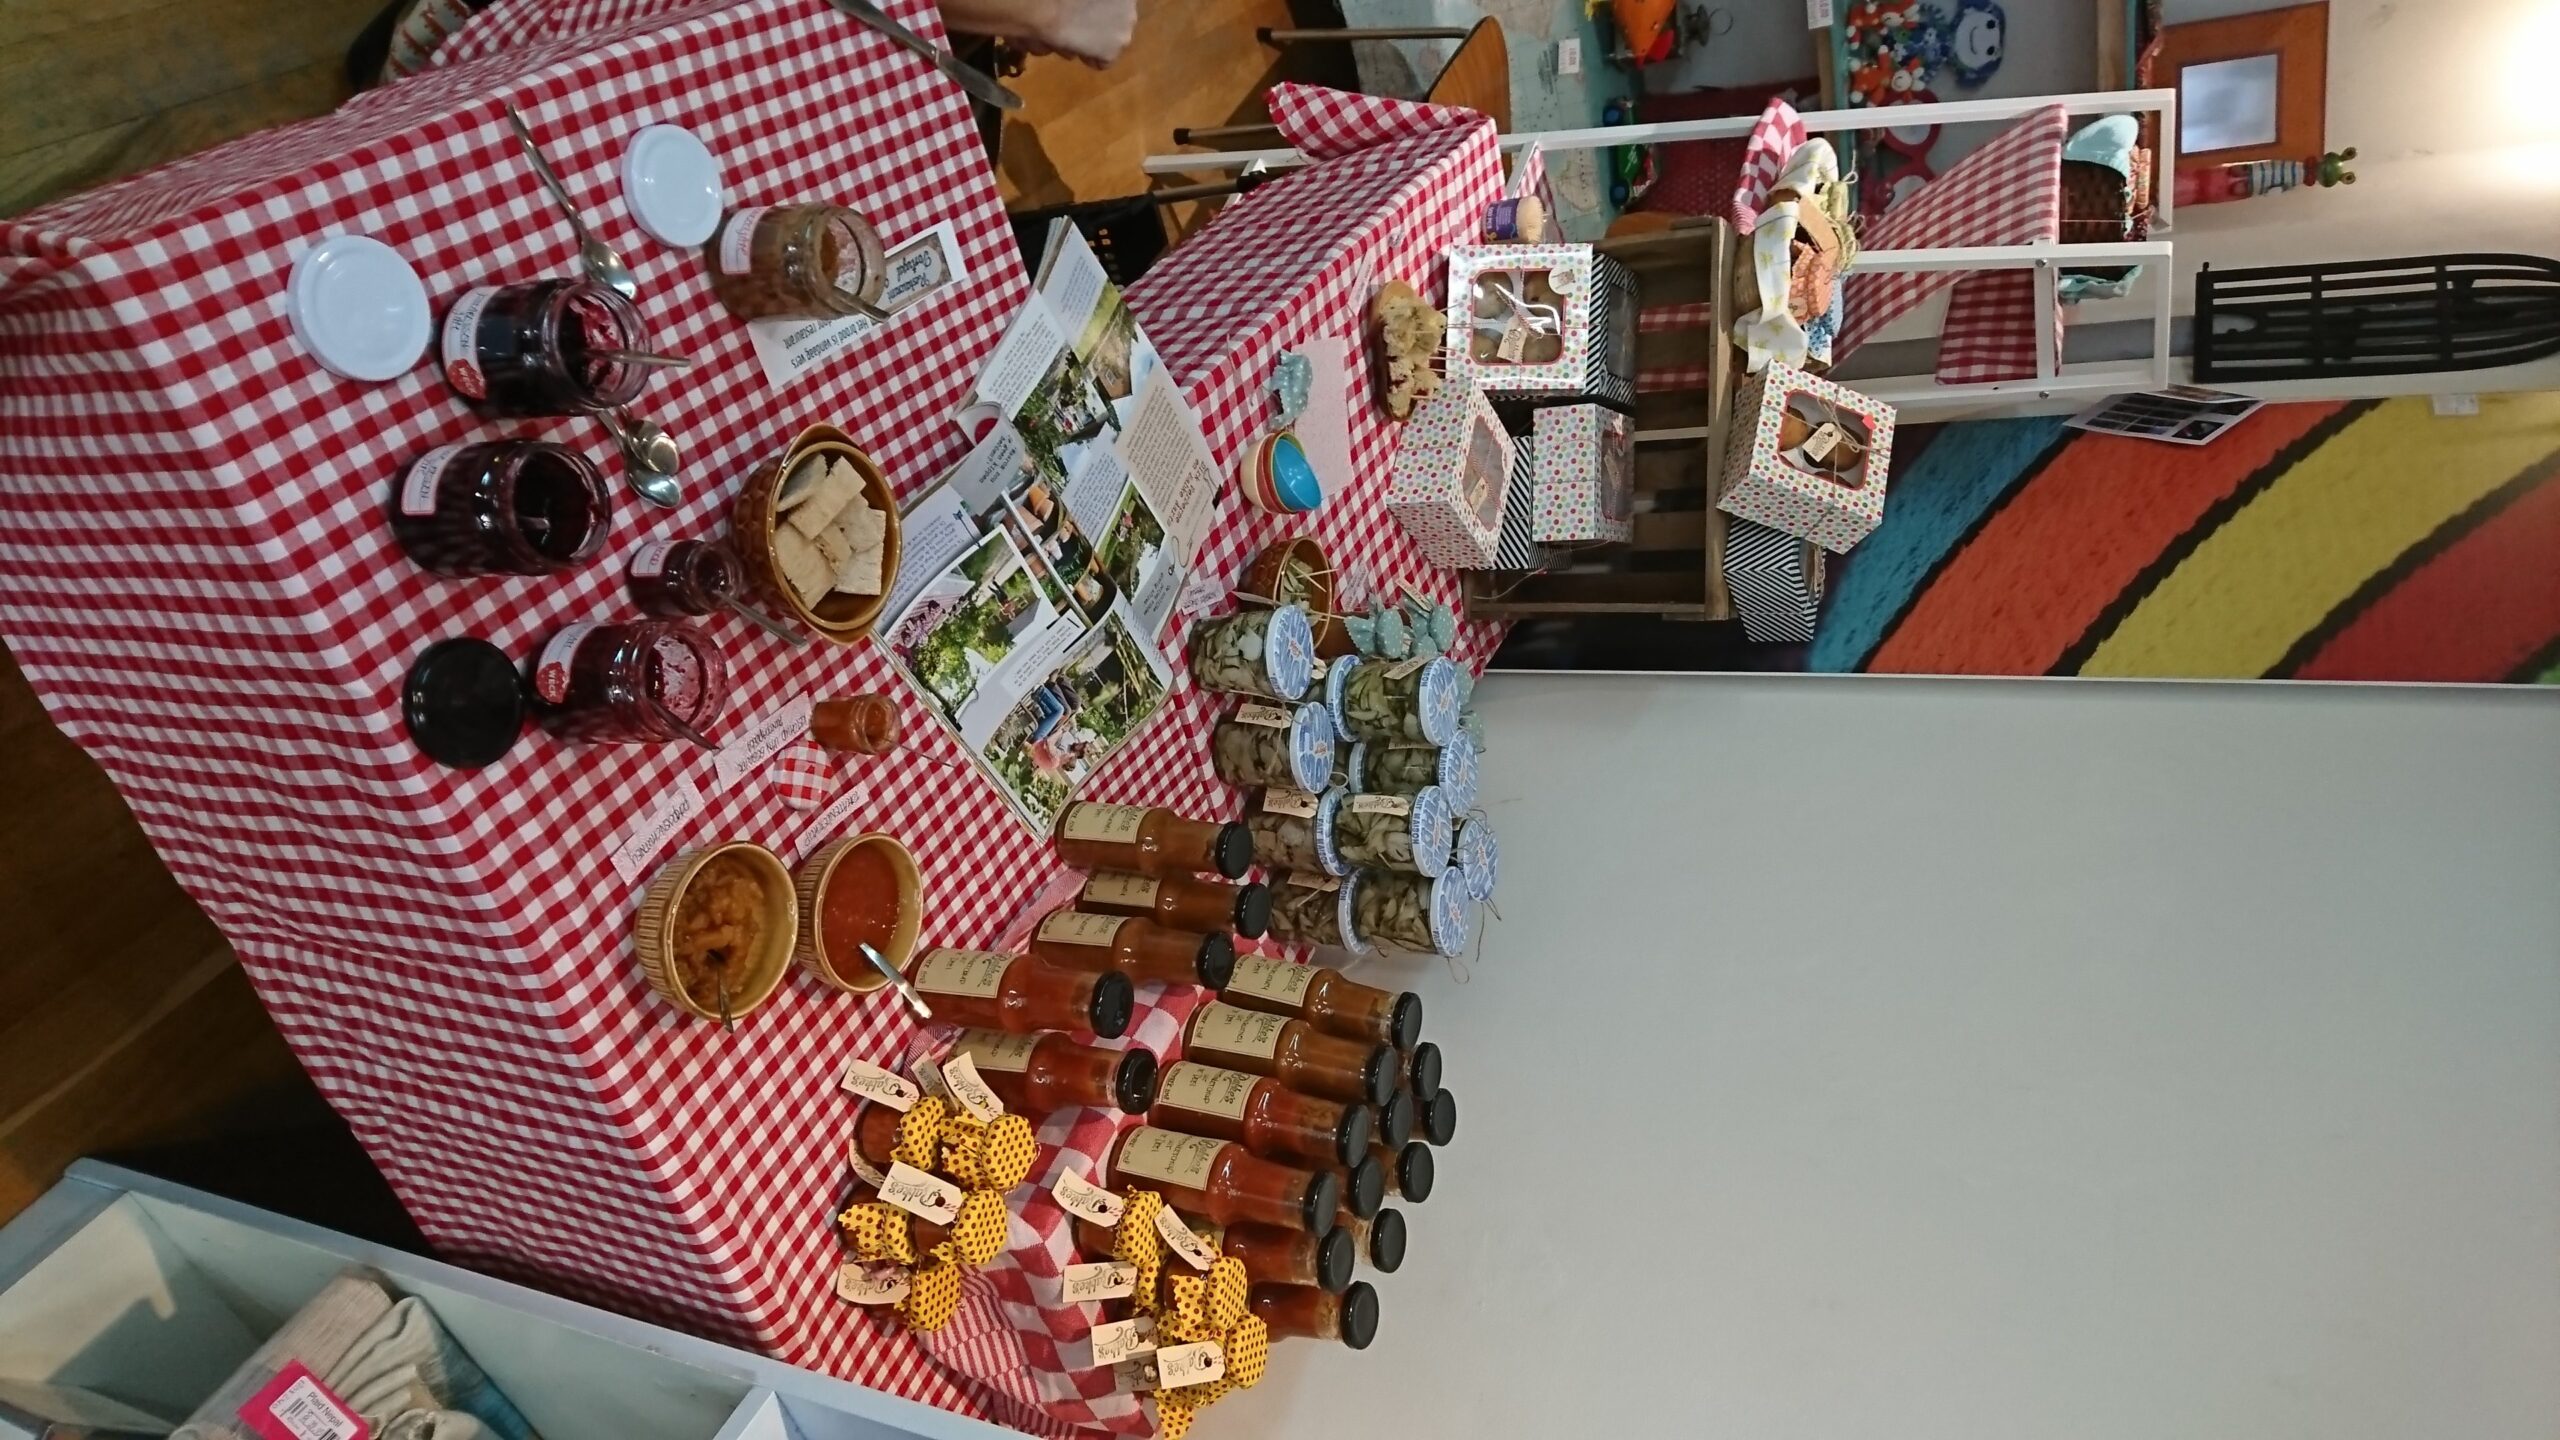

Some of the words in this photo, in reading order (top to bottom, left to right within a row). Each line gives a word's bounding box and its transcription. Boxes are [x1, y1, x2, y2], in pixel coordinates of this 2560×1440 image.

[783, 324, 818, 350] restaurant
[804, 338, 835, 361] vandaag
[830, 334, 840, 343] is
[790, 353, 810, 370] vers
[458, 366, 477, 394] WECK
[547, 669, 558, 698] WECK
[1411, 813, 1420, 845] MAISON
[306, 1391, 326, 1410] Plaid
[322, 1407, 344, 1429] Nepal
